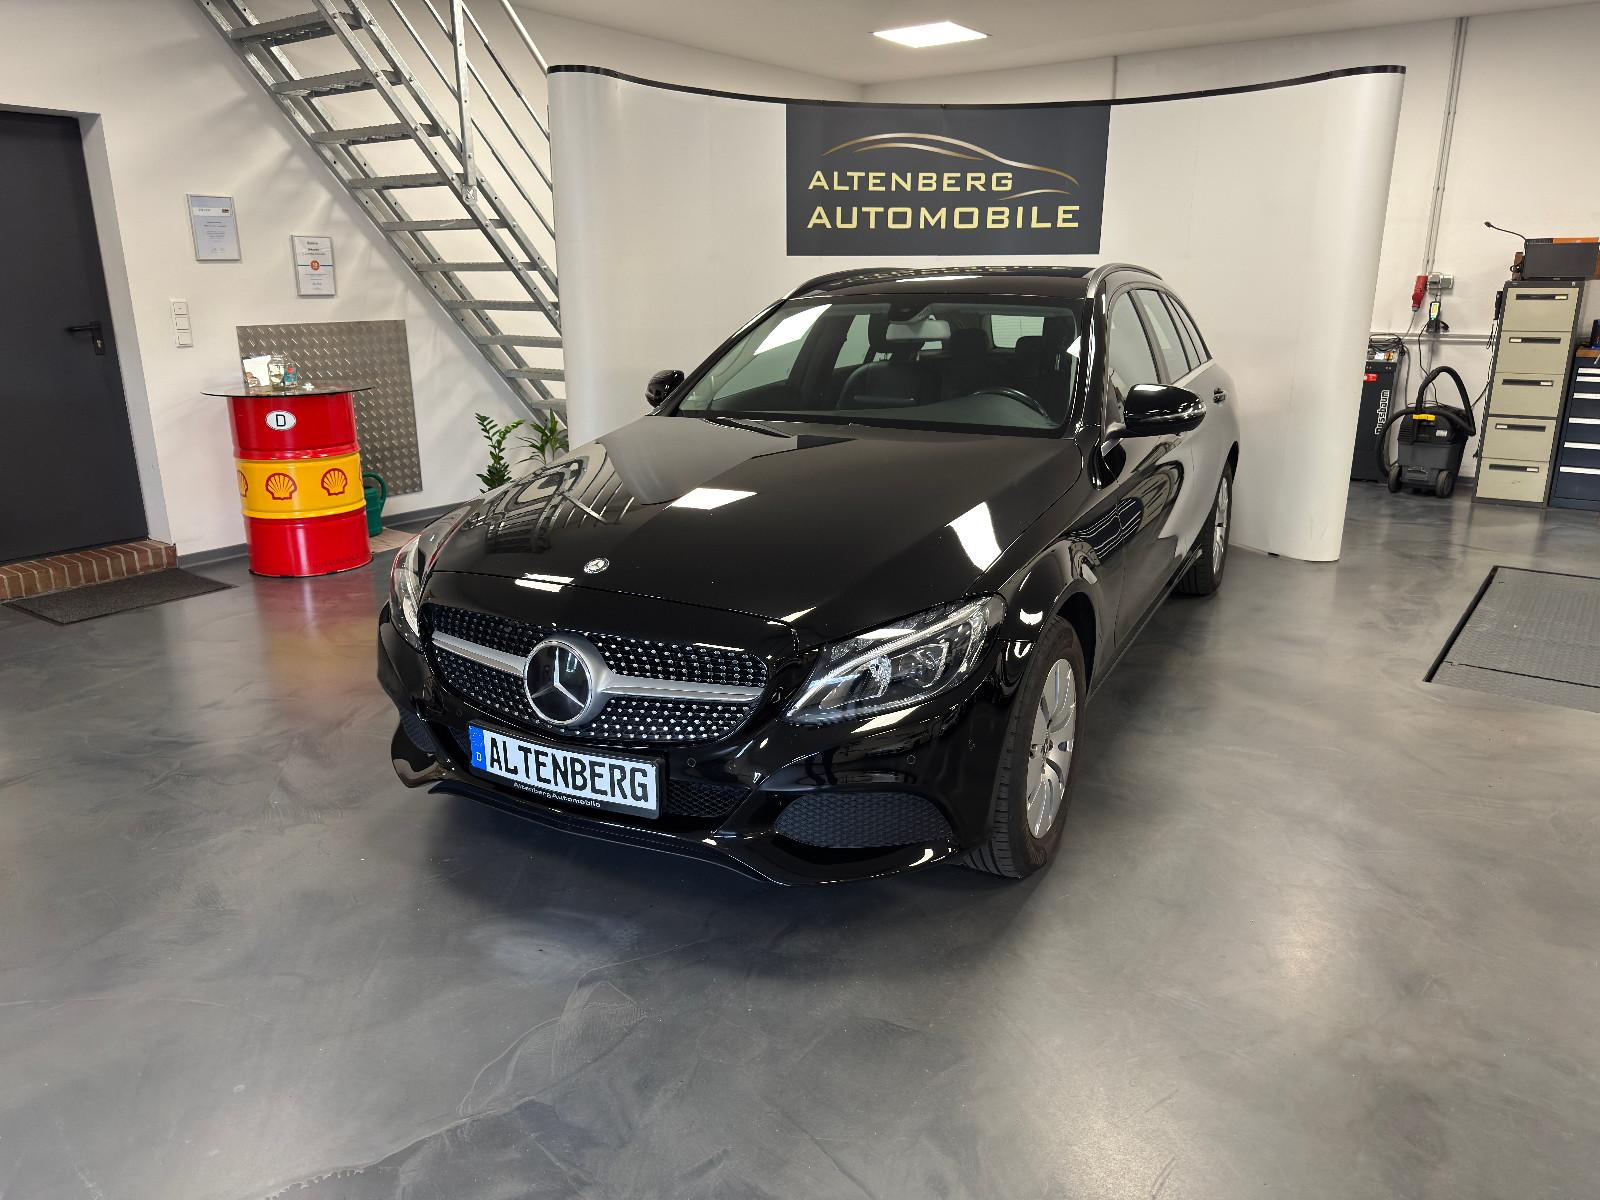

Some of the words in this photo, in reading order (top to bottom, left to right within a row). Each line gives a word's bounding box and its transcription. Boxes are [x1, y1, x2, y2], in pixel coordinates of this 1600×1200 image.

[808, 170, 1014, 192] ALTENBERG
[807, 205, 1080, 230] AUTOMOBILE
[275, 414, 287, 427] D
[475, 751, 482, 762] D
[490, 737, 649, 803] ALTENBERG
